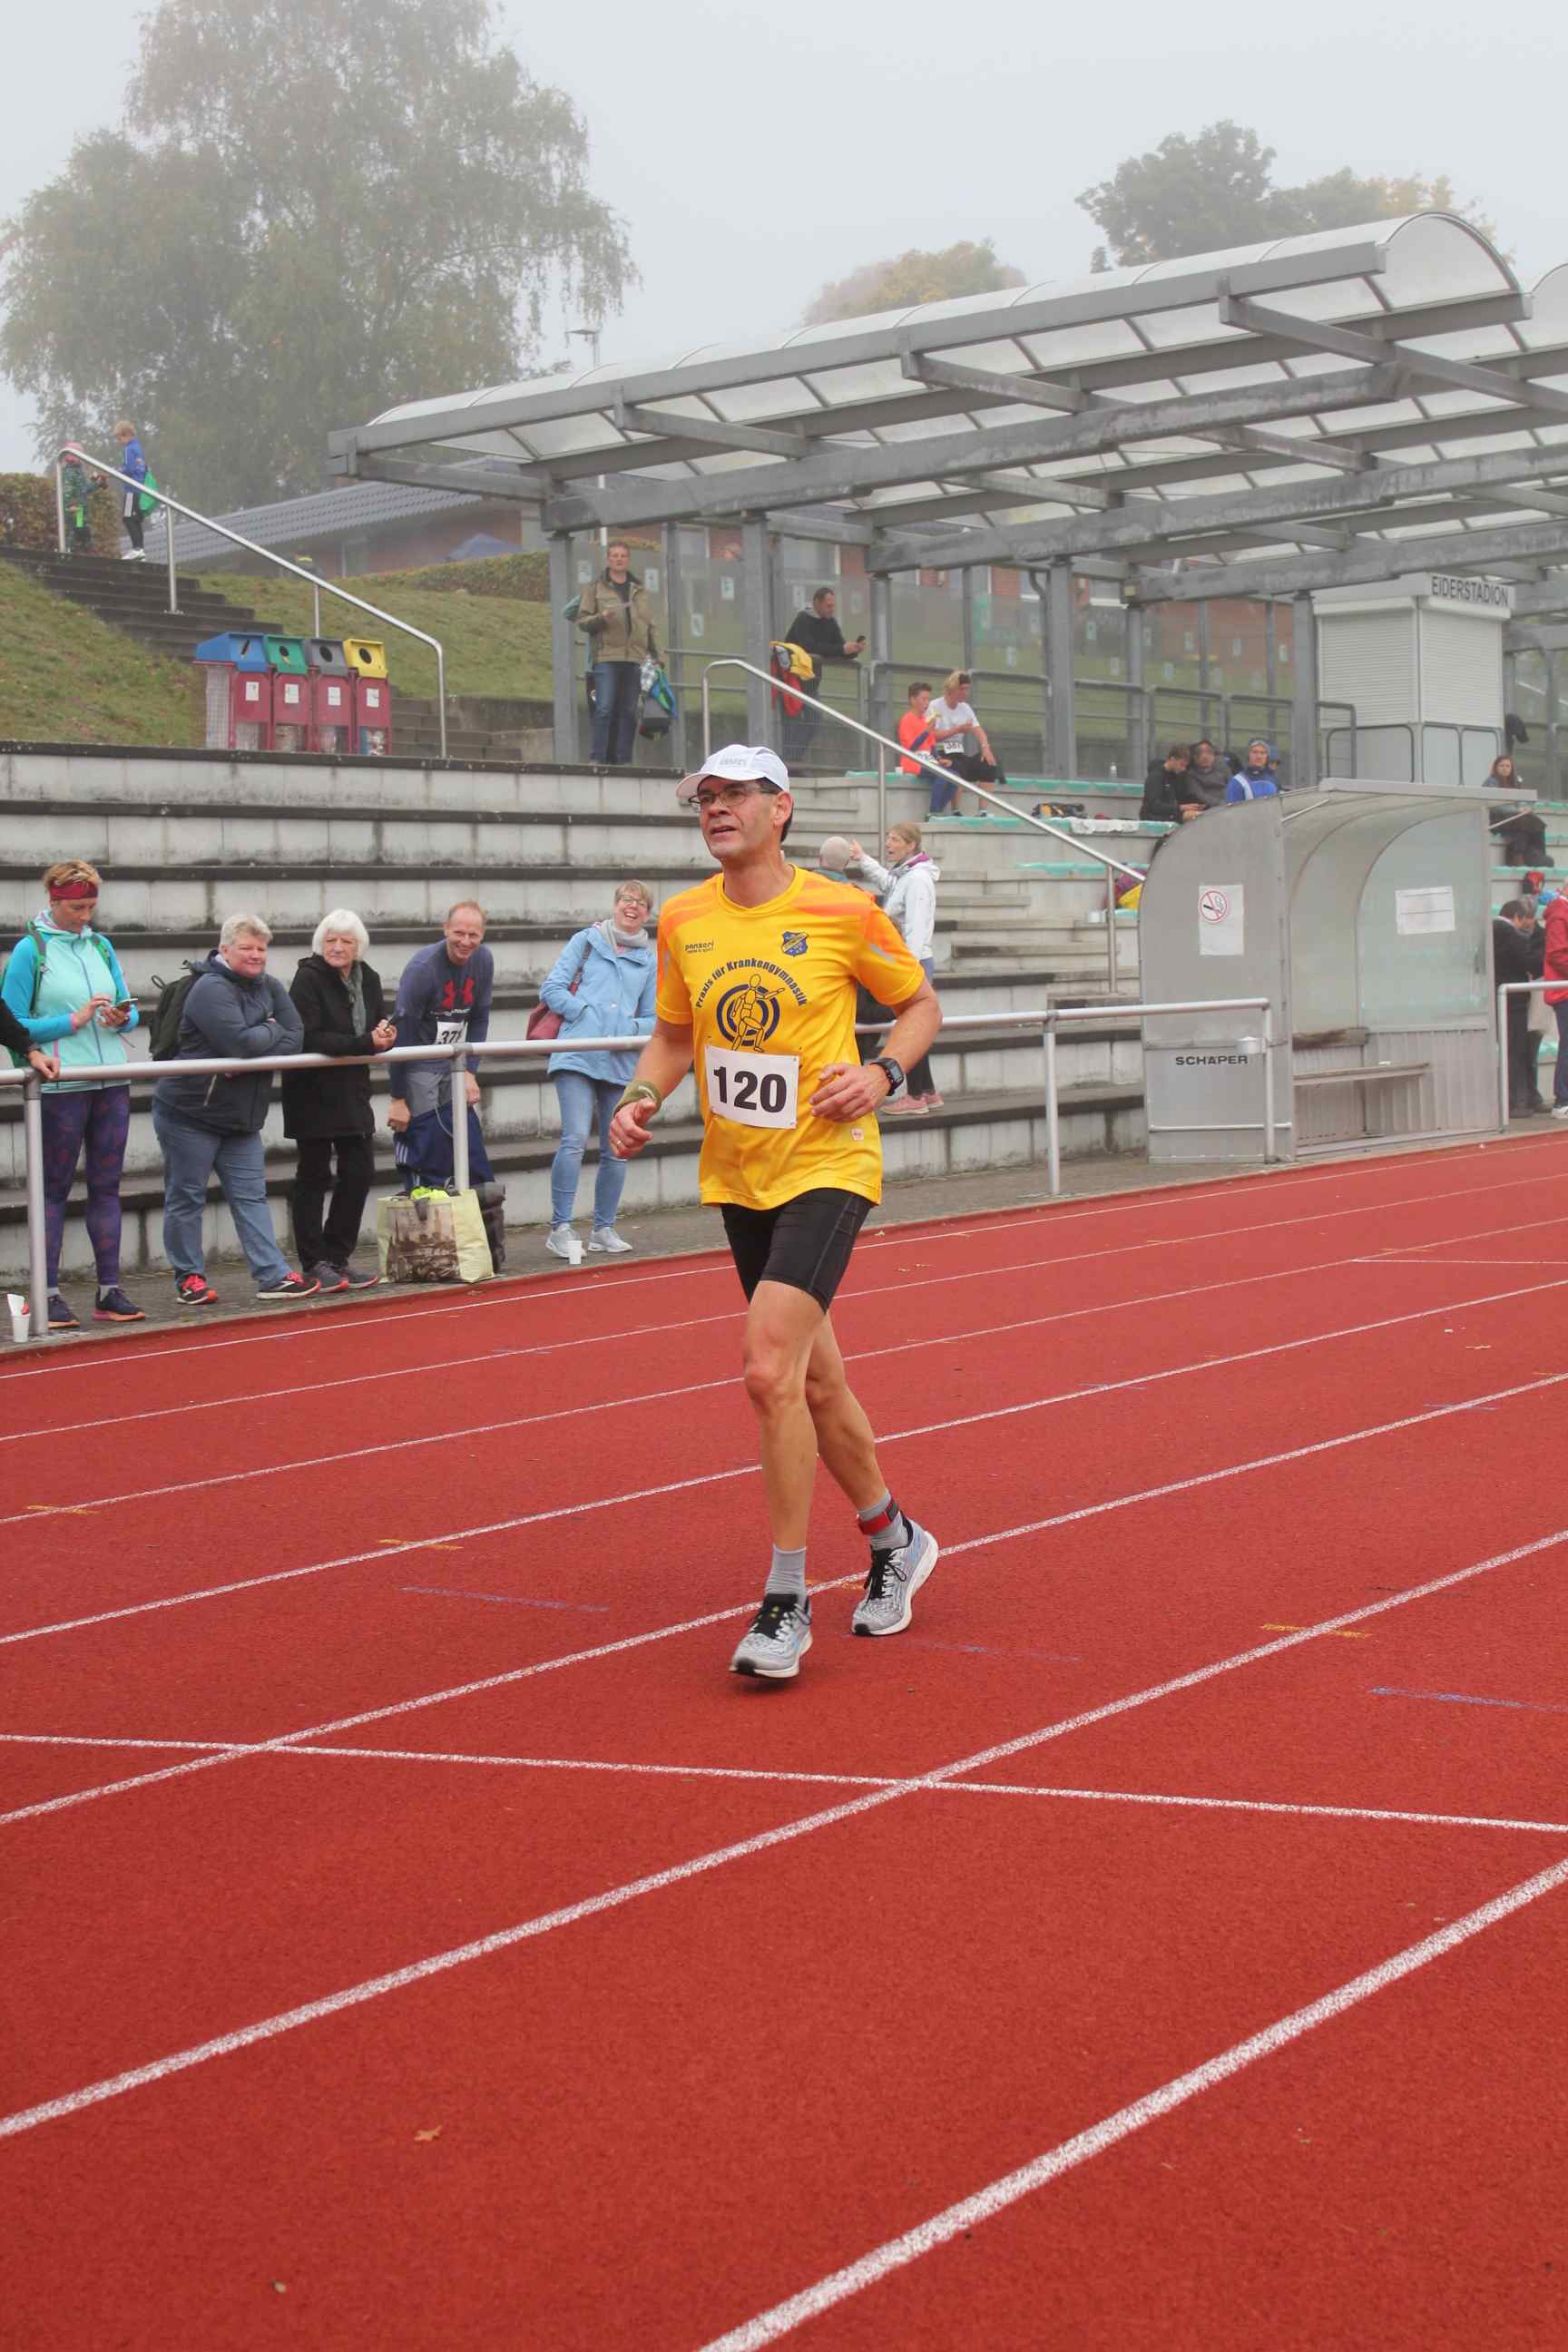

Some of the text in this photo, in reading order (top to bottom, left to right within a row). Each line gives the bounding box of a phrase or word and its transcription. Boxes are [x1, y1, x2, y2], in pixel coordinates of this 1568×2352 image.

[1432, 575, 1508, 608] EIDERSTADION
[695, 979, 714, 1008] Praxis
[726, 957, 808, 1007] Krankengymnastik
[712, 1065, 788, 1114] 120
